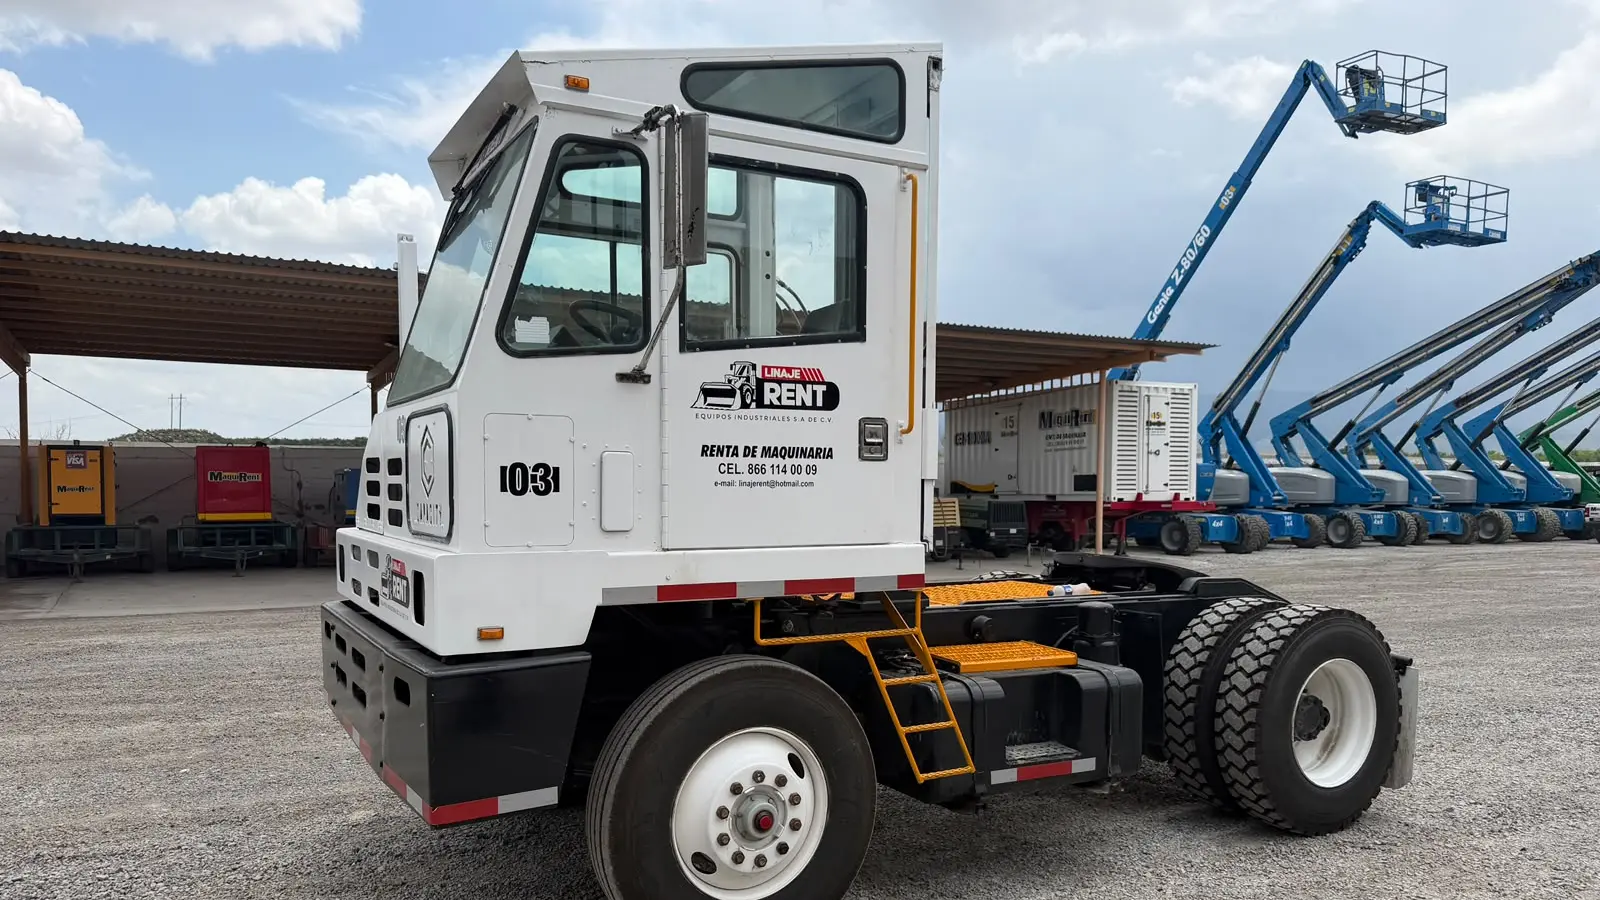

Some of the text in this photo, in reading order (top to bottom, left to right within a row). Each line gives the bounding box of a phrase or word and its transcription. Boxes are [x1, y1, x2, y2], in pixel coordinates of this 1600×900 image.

[1221, 189, 1234, 206] 03
[1147, 224, 1211, 324] Genie Z-80/60
[764, 367, 801, 379] LINAJE
[763, 382, 827, 407] RENT
[695, 413, 732, 421] EQUIPOS
[734, 414, 790, 422] INDUSTRIALES
[1004, 416, 1015, 429] 15
[700, 444, 834, 460] RENTA DE MAQUINARIA
[67, 455, 85, 467] VISA
[718, 462, 818, 476] CEL. 866 114 00 09
[208, 471, 261, 482] MaquiRent
[507, 461, 554, 497] 03
[714, 479, 815, 489] e-mail: linajerent@hotmail.com
[1212, 520, 1224, 528] 4x4
[392, 574, 407, 604] RENT
